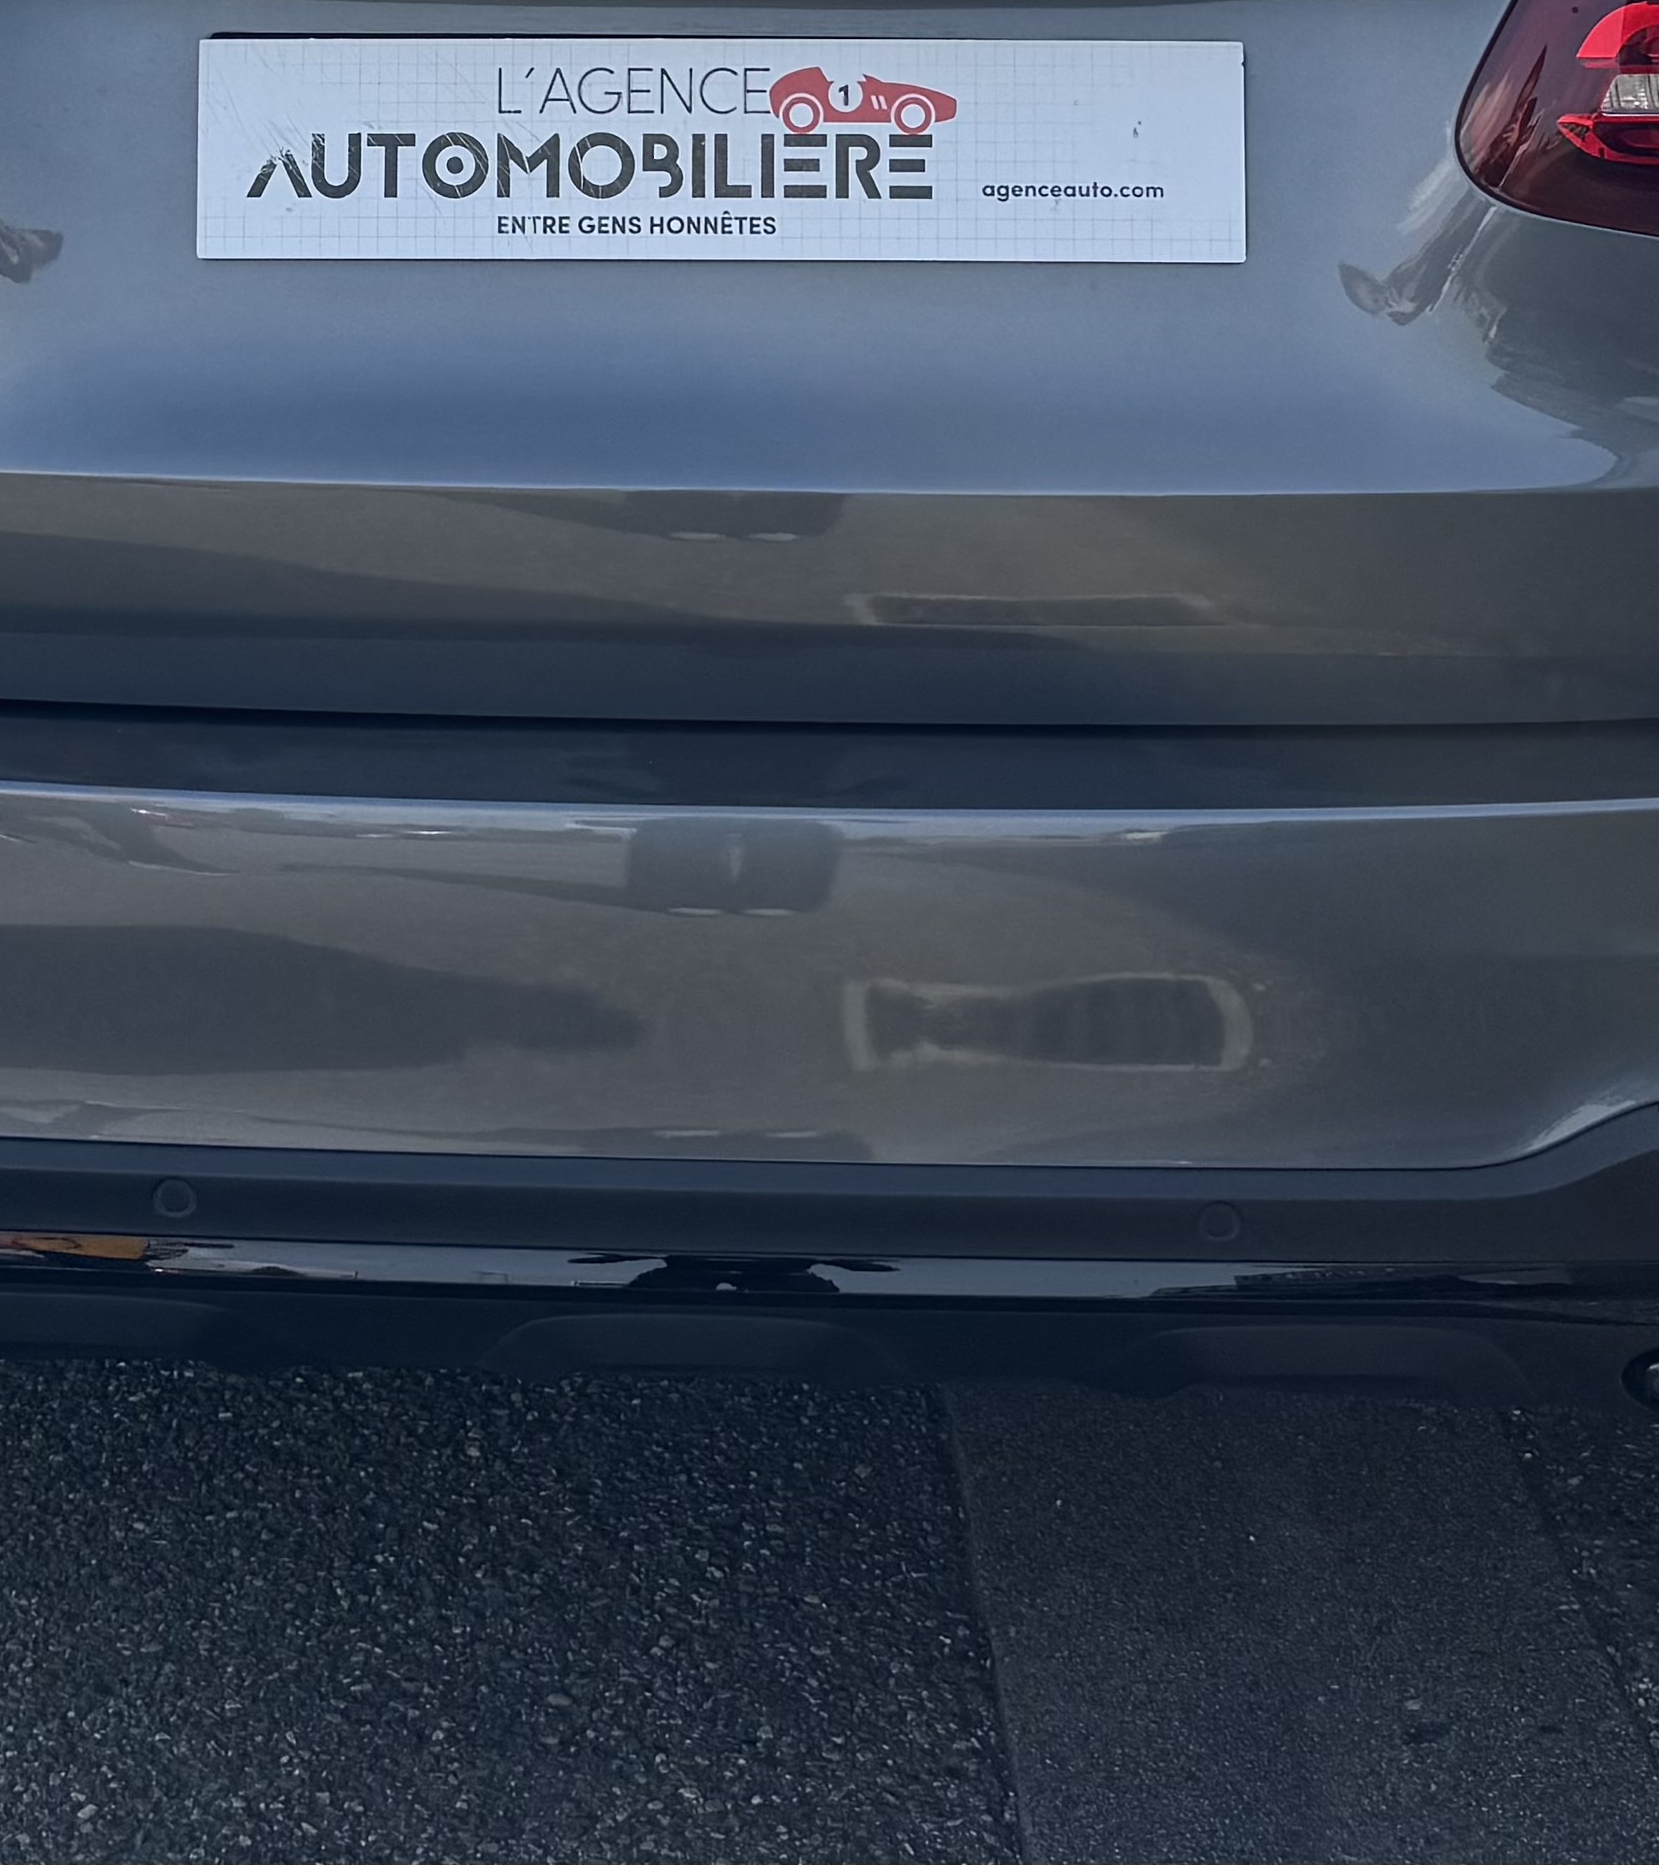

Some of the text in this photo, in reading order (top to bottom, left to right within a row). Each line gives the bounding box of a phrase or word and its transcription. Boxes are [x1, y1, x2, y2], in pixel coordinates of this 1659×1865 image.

[498, 67, 771, 115] L'AGENCE
[839, 84, 851, 107] 1
[982, 181, 1164, 202] agenceauto.com
[497, 210, 777, 235] ENTRE GENS HONNÊTES
